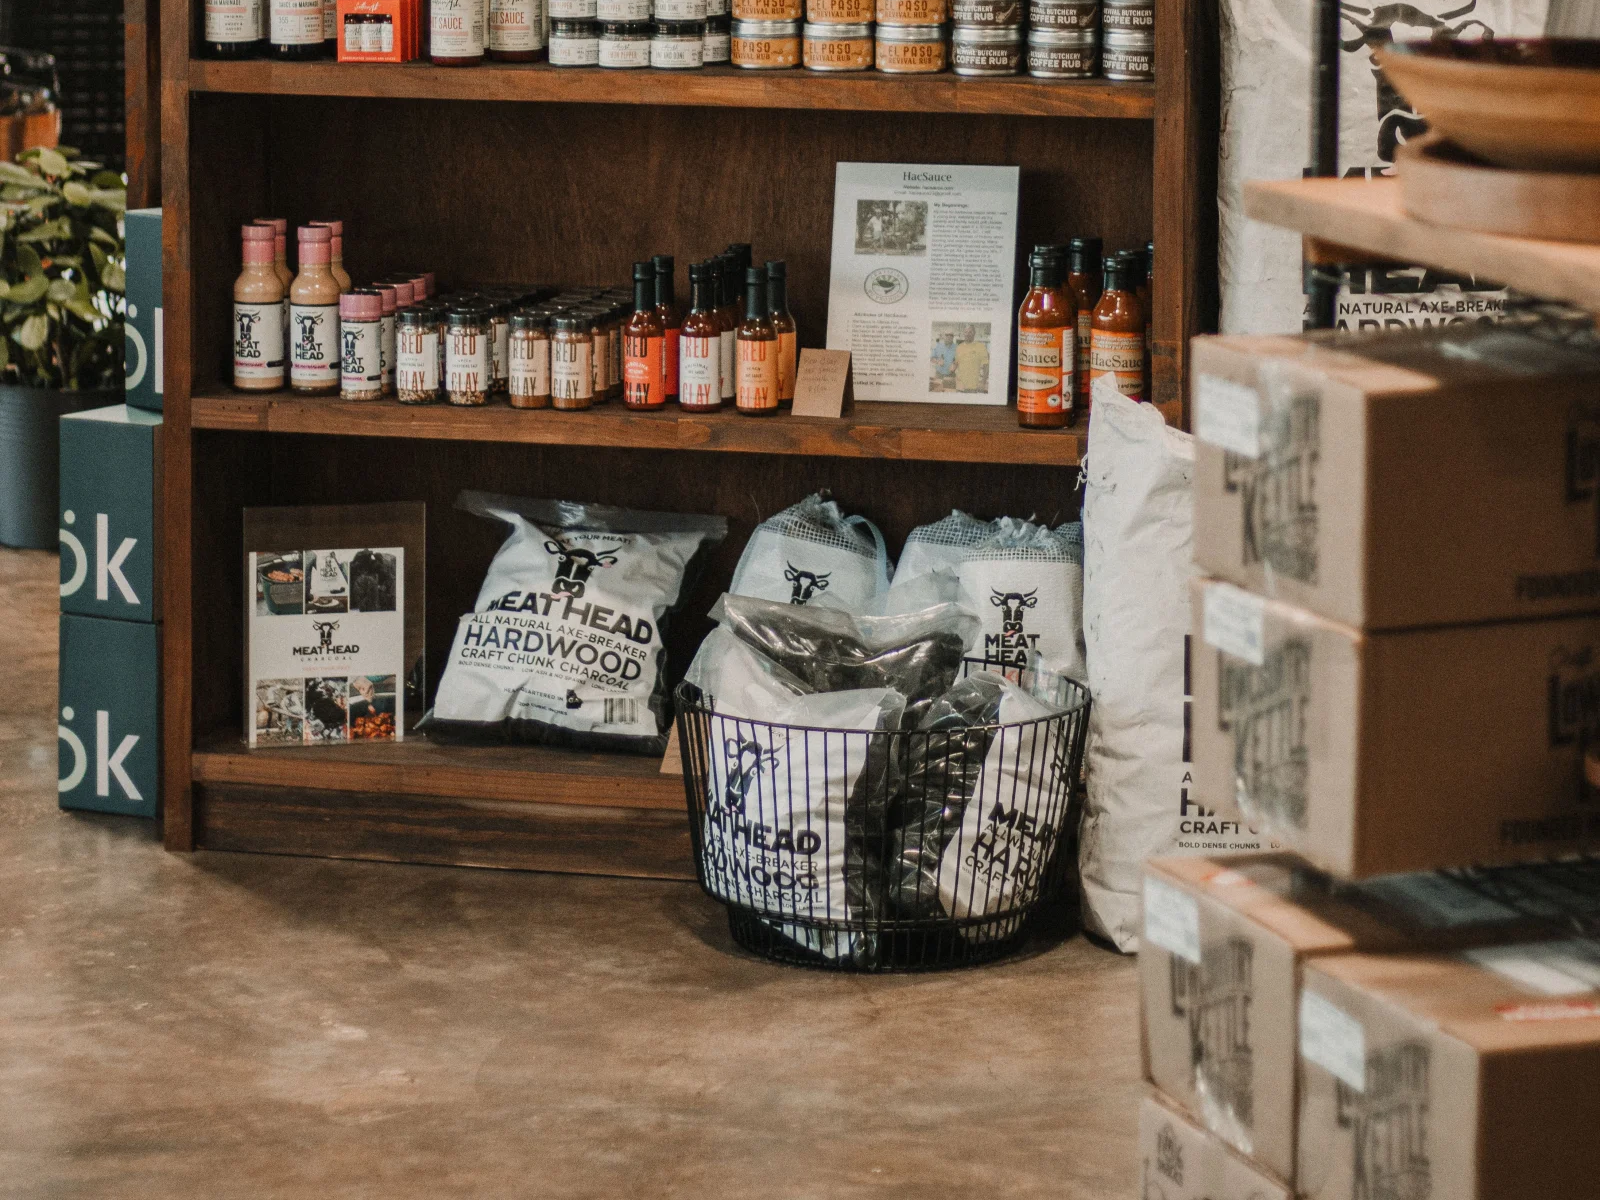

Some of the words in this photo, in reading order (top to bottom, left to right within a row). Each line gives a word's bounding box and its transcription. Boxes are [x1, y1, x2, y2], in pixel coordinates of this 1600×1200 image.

[816, 0, 826, 9] EL
[833, 0, 861, 10] PASO
[884, 0, 894, 10] EL
[898, 0, 928, 11] PASO
[500, 12, 525, 24] SAUCE
[954, 11, 972, 20] OFFEE
[974, 12, 994, 21] RUB
[1030, 14, 1055, 23] COFFEE
[1057, 15, 1077, 24] RUB
[1103, 15, 1130, 25] COFFEE
[1132, 17, 1153, 25] RUB
[438, 17, 463, 30] SAUCE
[733, 41, 740, 51] EL
[742, 42, 770, 53] PASO
[809, 42, 819, 54] EL
[821, 43, 850, 54] PASO
[888, 45, 897, 56] EL
[903, 46, 932, 57] PASO
[956, 56, 987, 65] COFFEE
[989, 57, 1008, 65] RUB
[1050, 52, 1080, 60] BUTCHERY
[1120, 55, 1148, 63] BUTCHERY
[1030, 58, 1058, 67] COFFEE
[1060, 59, 1081, 68] RUB
[1103, 61, 1129, 70] COFFEE
[1131, 62, 1149, 71] RUB
[903, 171, 952, 181] HacSauce
[1339, 302, 1414, 315] NATURAL
[1419, 299, 1508, 313] AXE-BREAK
[295, 343, 322, 352] MEAT
[401, 333, 423, 355] RED
[454, 334, 476, 356] RED
[512, 339, 534, 361] RED
[626, 336, 648, 358] RED
[685, 337, 709, 358] RED
[235, 350, 261, 359] HEAD
[295, 352, 324, 360] HEAD
[555, 341, 577, 363] RED
[742, 340, 767, 362] RED
[1019, 351, 1058, 364] Sauce
[1091, 352, 1142, 369] HacSauc
[341, 365, 365, 374] HEAD
[400, 371, 425, 391] CLAY
[451, 372, 479, 392] CLAY
[511, 377, 537, 397] CLAY
[553, 379, 579, 399] CLAY
[624, 382, 650, 404] CLAY
[683, 383, 711, 405] CLAY
[739, 386, 769, 408] CLAY
[574, 534, 600, 542] YOUR
[562, 595, 653, 645] HEAD
[472, 614, 490, 624] ALL
[494, 616, 552, 631] NATURAL
[557, 625, 647, 661] AXE-BREAKER
[985, 634, 1040, 649] MEAT
[293, 646, 322, 656] MEAT
[326, 644, 360, 655] HEAD
[463, 624, 642, 681] HARDWOOD
[985, 649, 1027, 664] HEA
[461, 647, 504, 661] CRAFT
[507, 652, 556, 670] CHUNK
[560, 661, 629, 691] CHARCOAL
[1180, 821, 1239, 835] CRAFT
